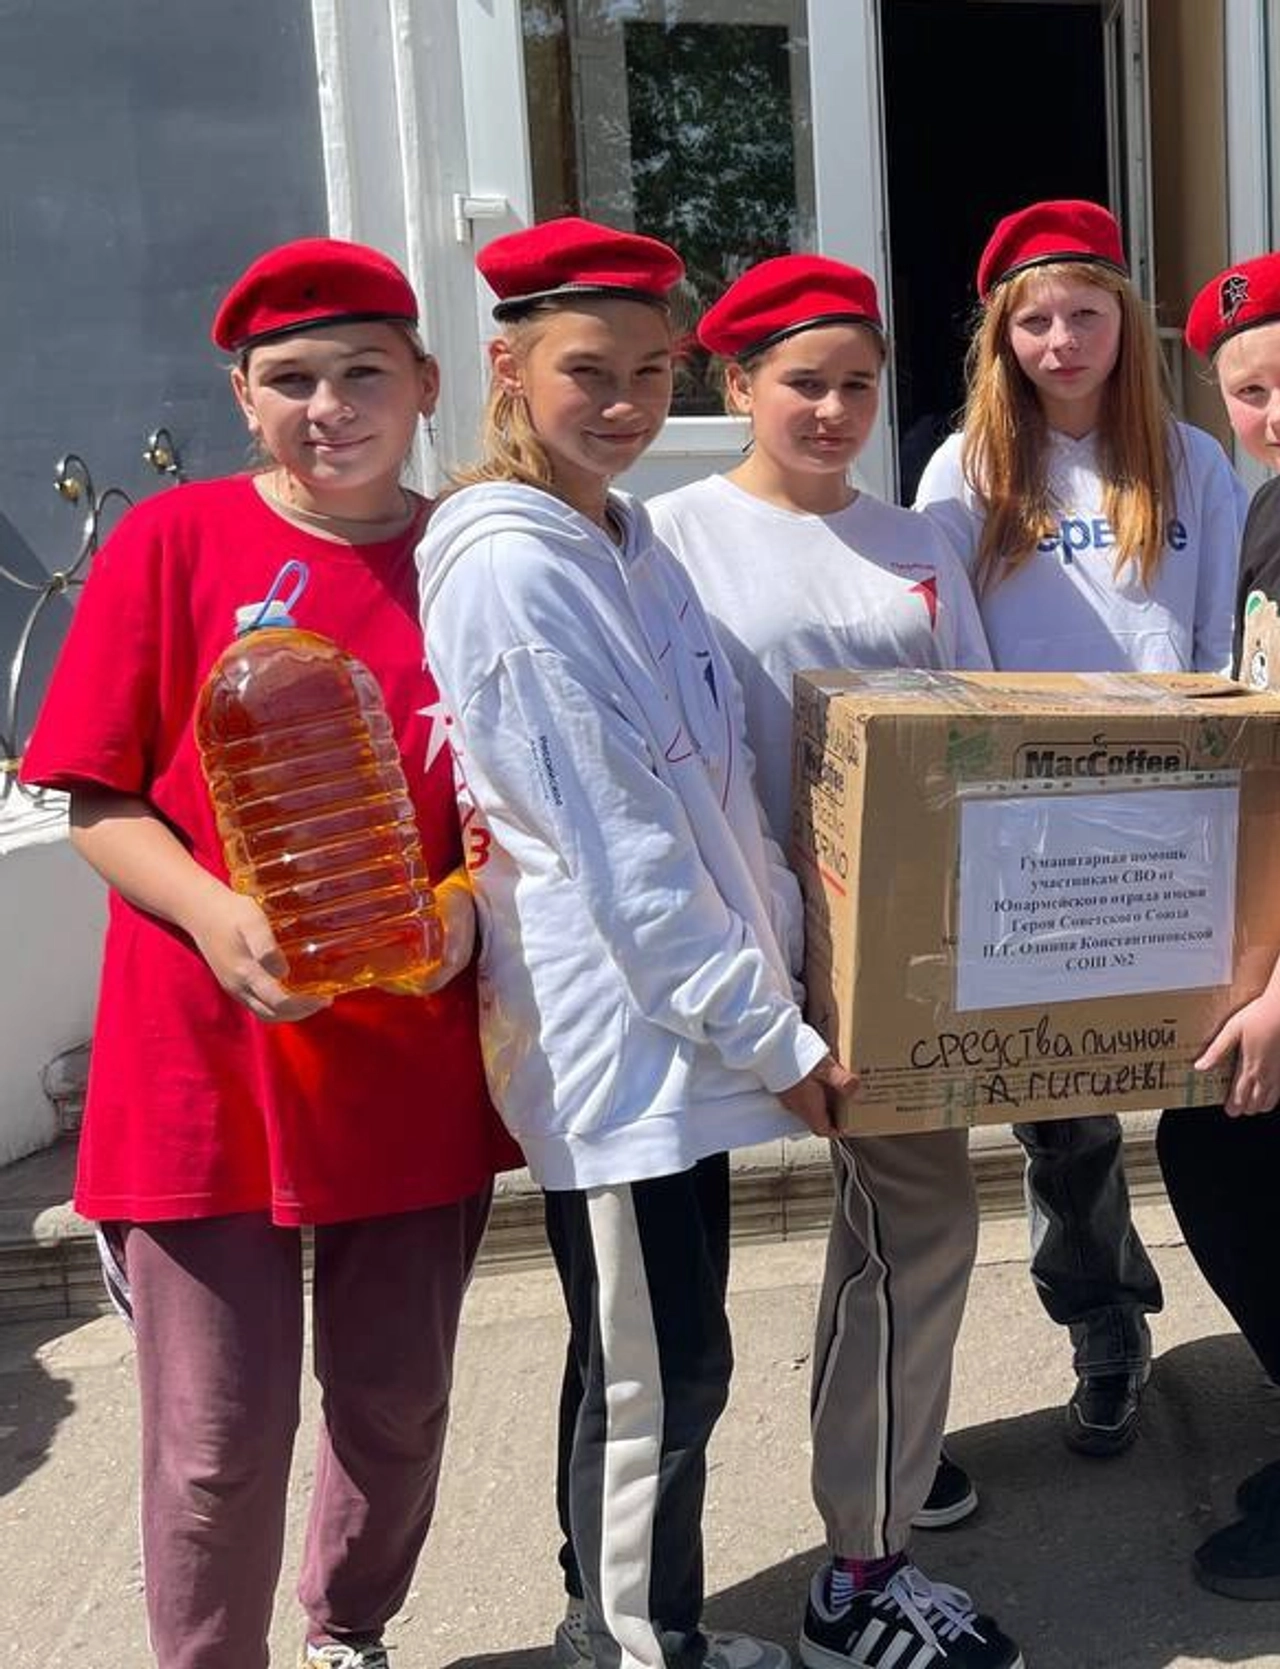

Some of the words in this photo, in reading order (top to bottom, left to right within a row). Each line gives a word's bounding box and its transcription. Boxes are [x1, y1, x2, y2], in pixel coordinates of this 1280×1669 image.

[1025, 747, 1182, 779] MacCoffee
[1020, 851, 1127, 871] Гуманитарная
[1130, 849, 1188, 865] помощь
[1031, 876, 1118, 893] участникам
[1121, 870, 1156, 884] СВО
[994, 894, 1108, 913] Юнармейского
[1111, 890, 1160, 906] отряда
[1163, 886, 1208, 899] имени
[1012, 917, 1055, 933] Героя
[1060, 911, 1142, 929] Советского
[1145, 906, 1190, 921] Союза
[1081, 928, 1214, 951] Константиновской
[1065, 956, 1106, 971] СОШ
[1110, 952, 1136, 967] №2
